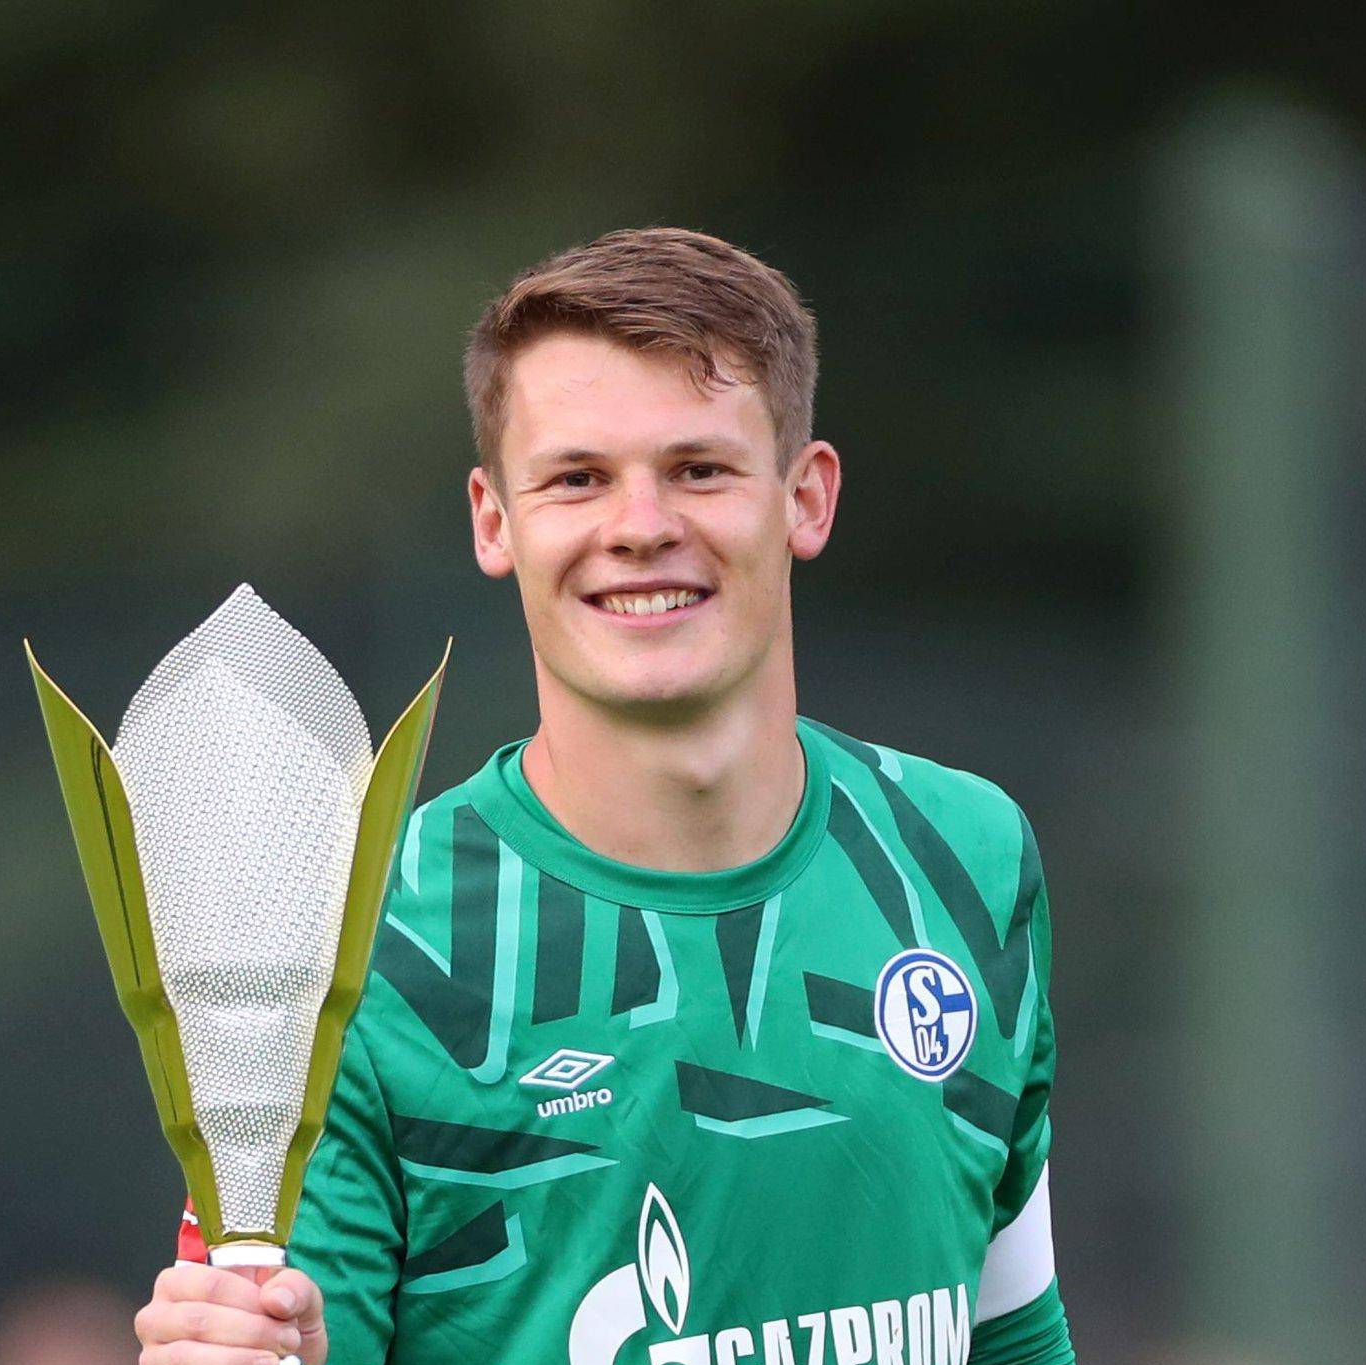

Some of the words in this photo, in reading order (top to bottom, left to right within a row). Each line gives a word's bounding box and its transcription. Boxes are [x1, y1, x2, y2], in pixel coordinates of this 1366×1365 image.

[909, 967, 941, 1027] S
[915, 1025, 943, 1064] 04
[537, 1088, 612, 1118] umbro
